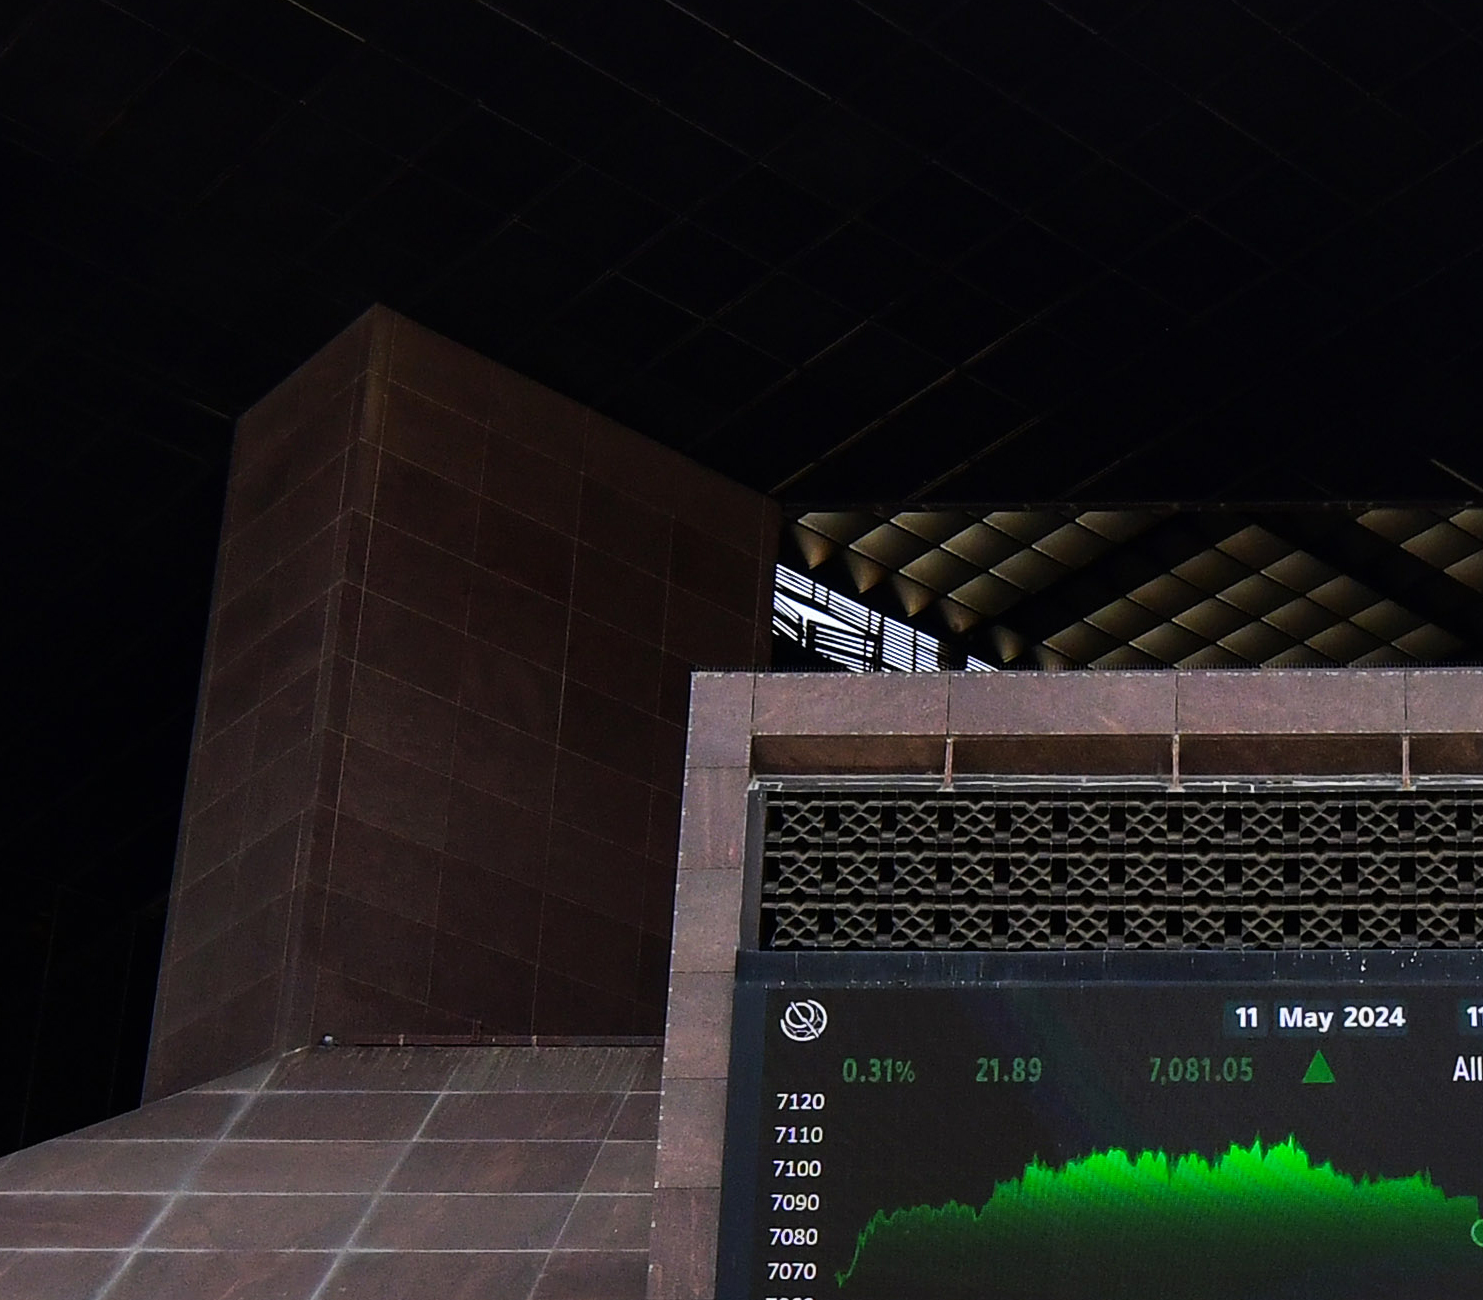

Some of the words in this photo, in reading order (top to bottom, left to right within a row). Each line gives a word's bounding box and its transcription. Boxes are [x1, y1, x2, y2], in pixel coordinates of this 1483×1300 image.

[1235, 1006, 1258, 1028] 11
[1278, 1006, 1334, 1033] May
[1343, 1006, 1406, 1028] 2024
[842, 1057, 916, 1083] 0.31%
[975, 1056, 1043, 1083] 21.89
[1149, 1056, 1253, 1086] 7,081.05
[776, 1093, 825, 1110] 7120
[774, 1126, 823, 1144] 7110
[772, 1159, 822, 1177] 7100
[770, 1193, 820, 1211] 7090
[769, 1228, 818, 1246] 7080
[767, 1262, 817, 1280] 7070
